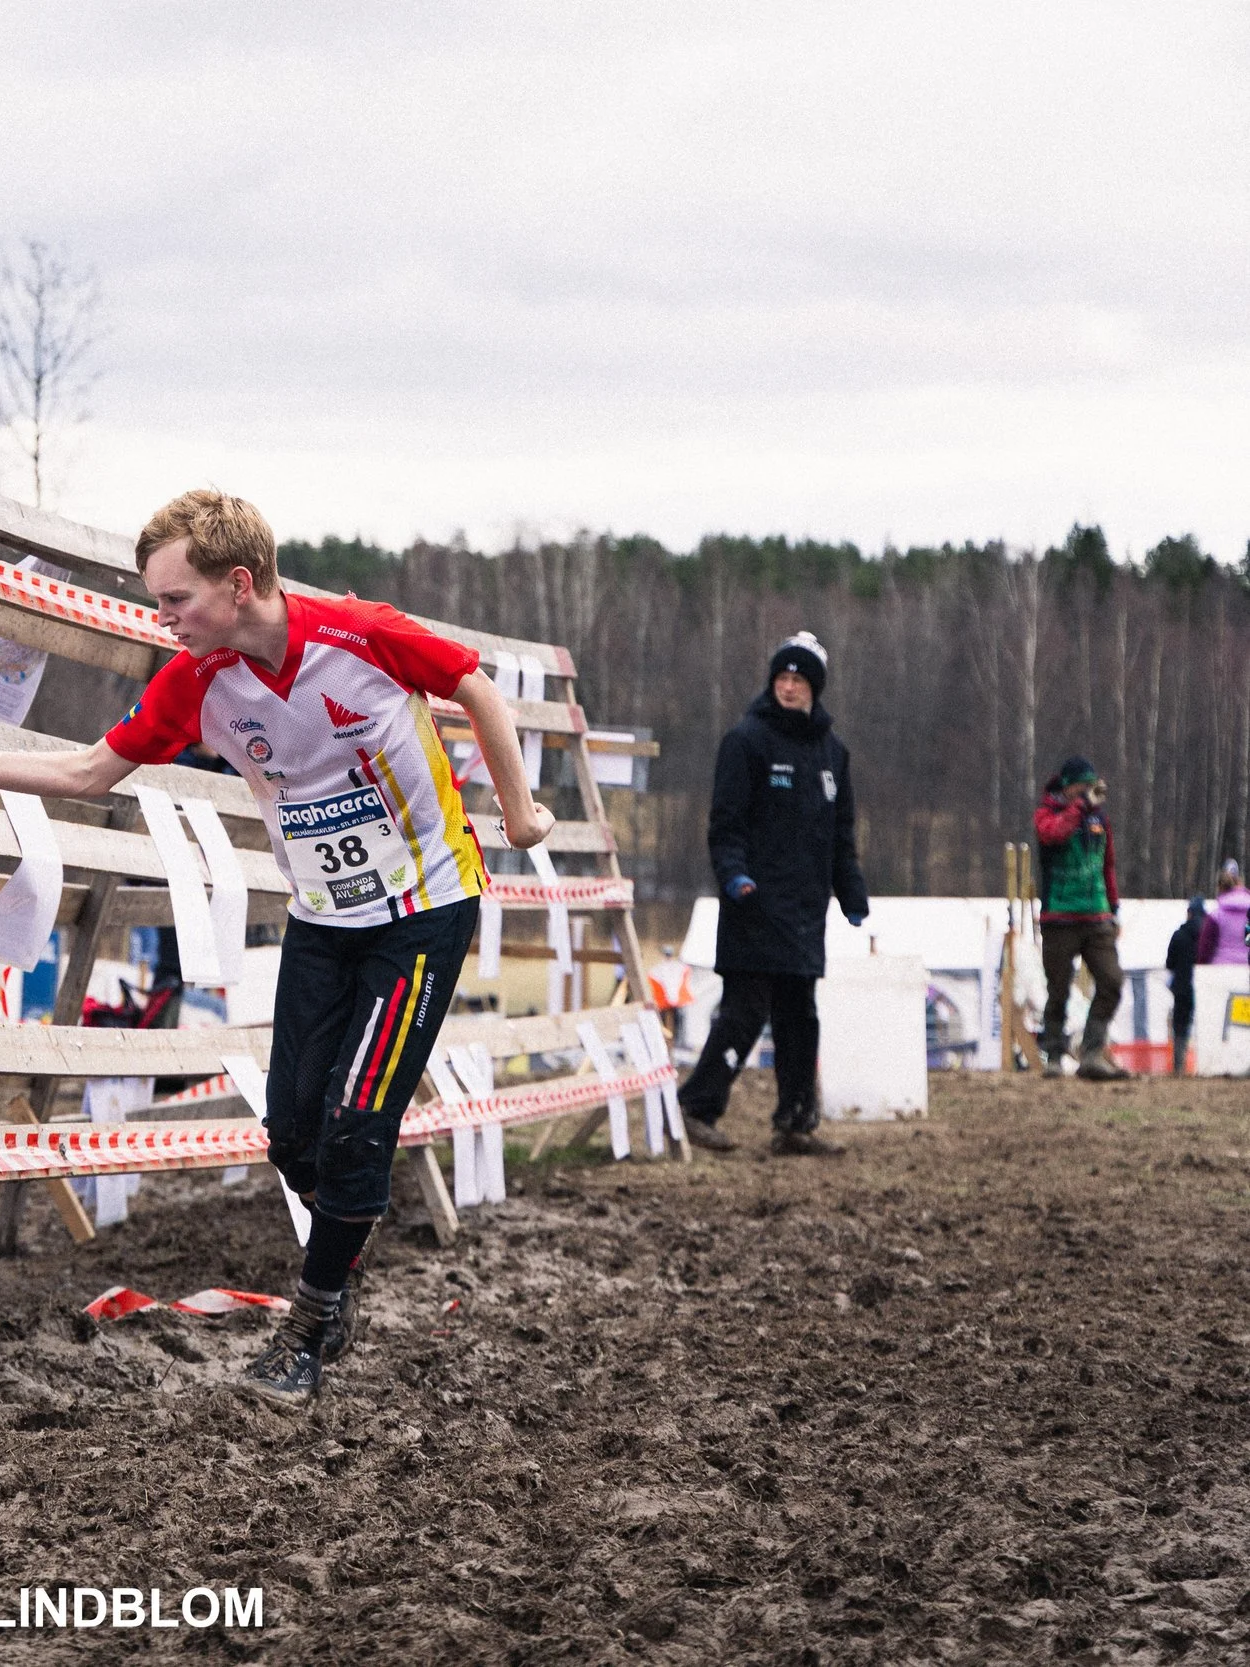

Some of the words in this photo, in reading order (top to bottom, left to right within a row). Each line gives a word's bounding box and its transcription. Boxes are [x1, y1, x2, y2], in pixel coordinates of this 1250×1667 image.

[317, 624, 368, 647] noname
[194, 649, 235, 678] noname
[279, 791, 381, 826] bagheera
[340, 821, 351, 829] STL
[378, 823, 392, 836] 3
[314, 835, 369, 873] 38
[331, 876, 375, 891] GODKÄNDA
[415, 971, 435, 1028] noname
